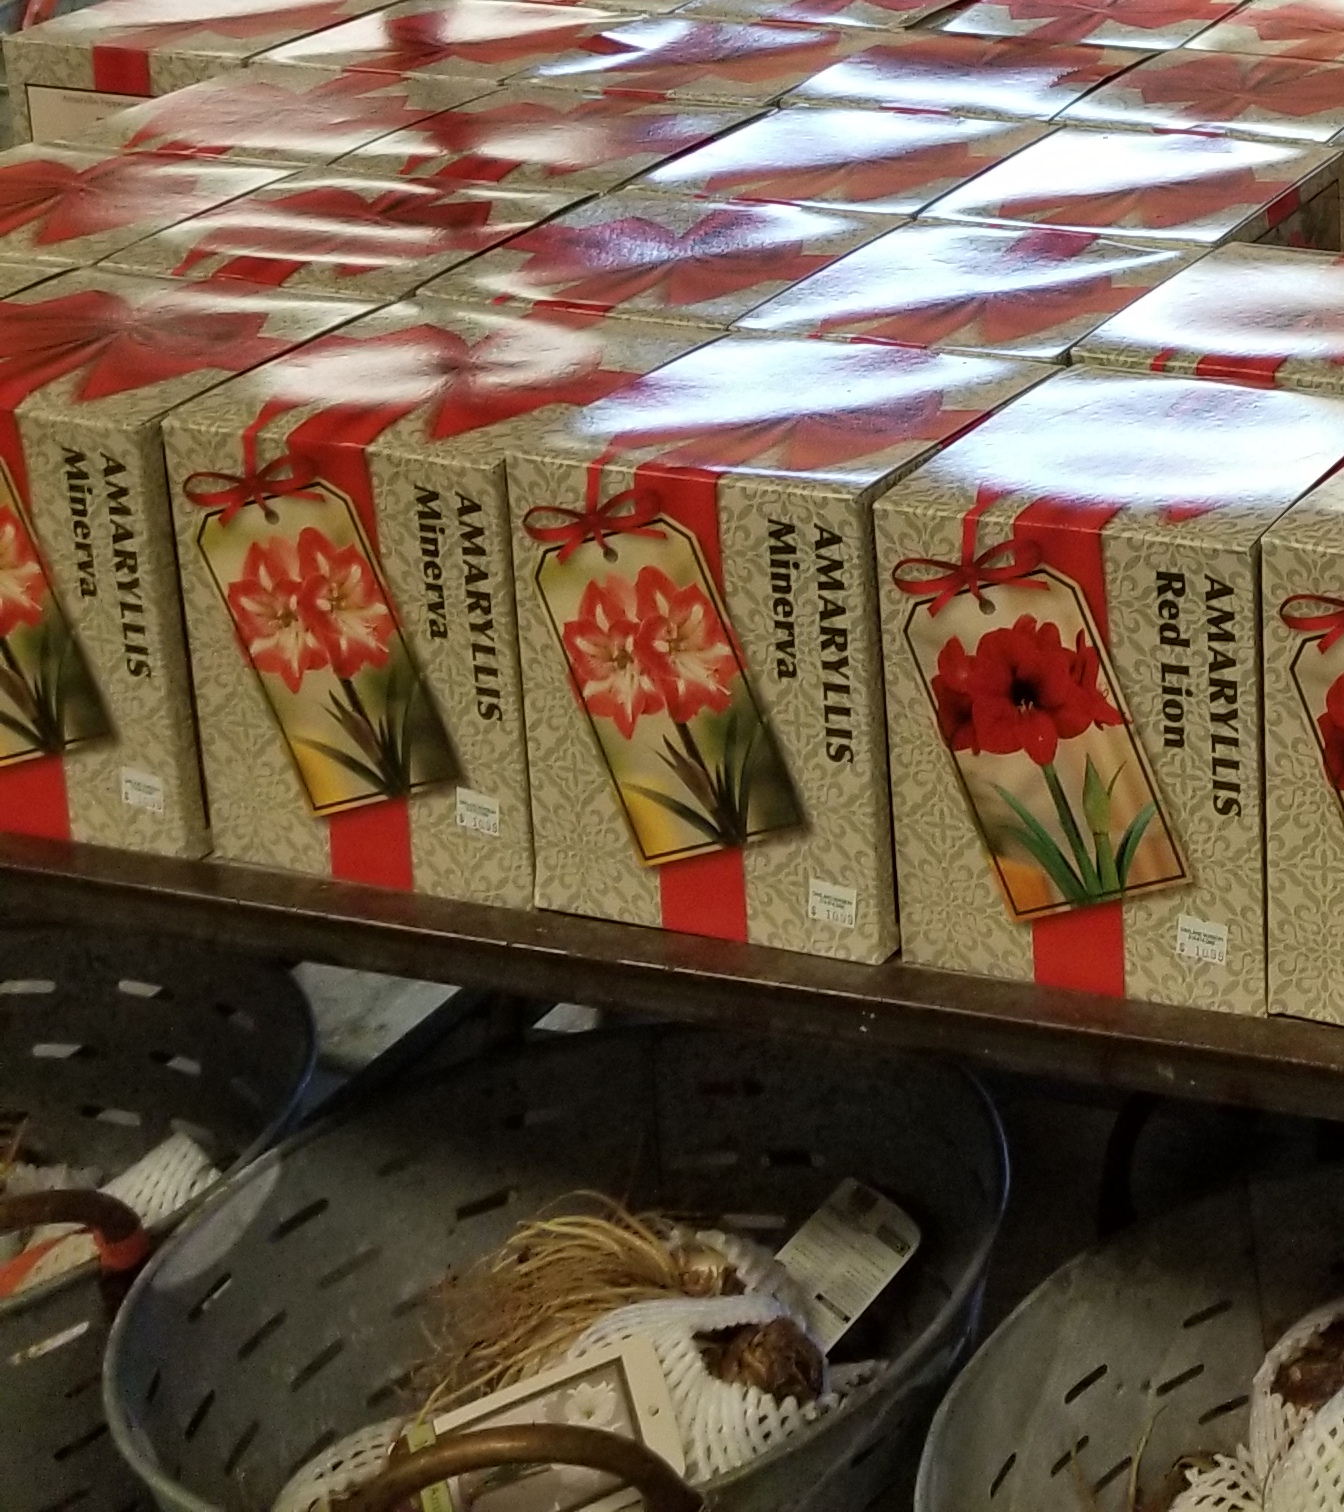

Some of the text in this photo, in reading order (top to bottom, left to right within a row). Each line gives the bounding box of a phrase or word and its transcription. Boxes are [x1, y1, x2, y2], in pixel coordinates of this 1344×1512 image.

[62, 447, 97, 598] Minerva
[100, 451, 152, 680] AMARYLLIS
[414, 485, 449, 641] Minerva
[455, 491, 503, 722] AMARYLLIS
[767, 518, 798, 682] Minerva
[814, 523, 854, 765] AMARYLLIS
[1155, 570, 1191, 748] Red Lion
[1204, 573, 1242, 818] AMARYLLIS
